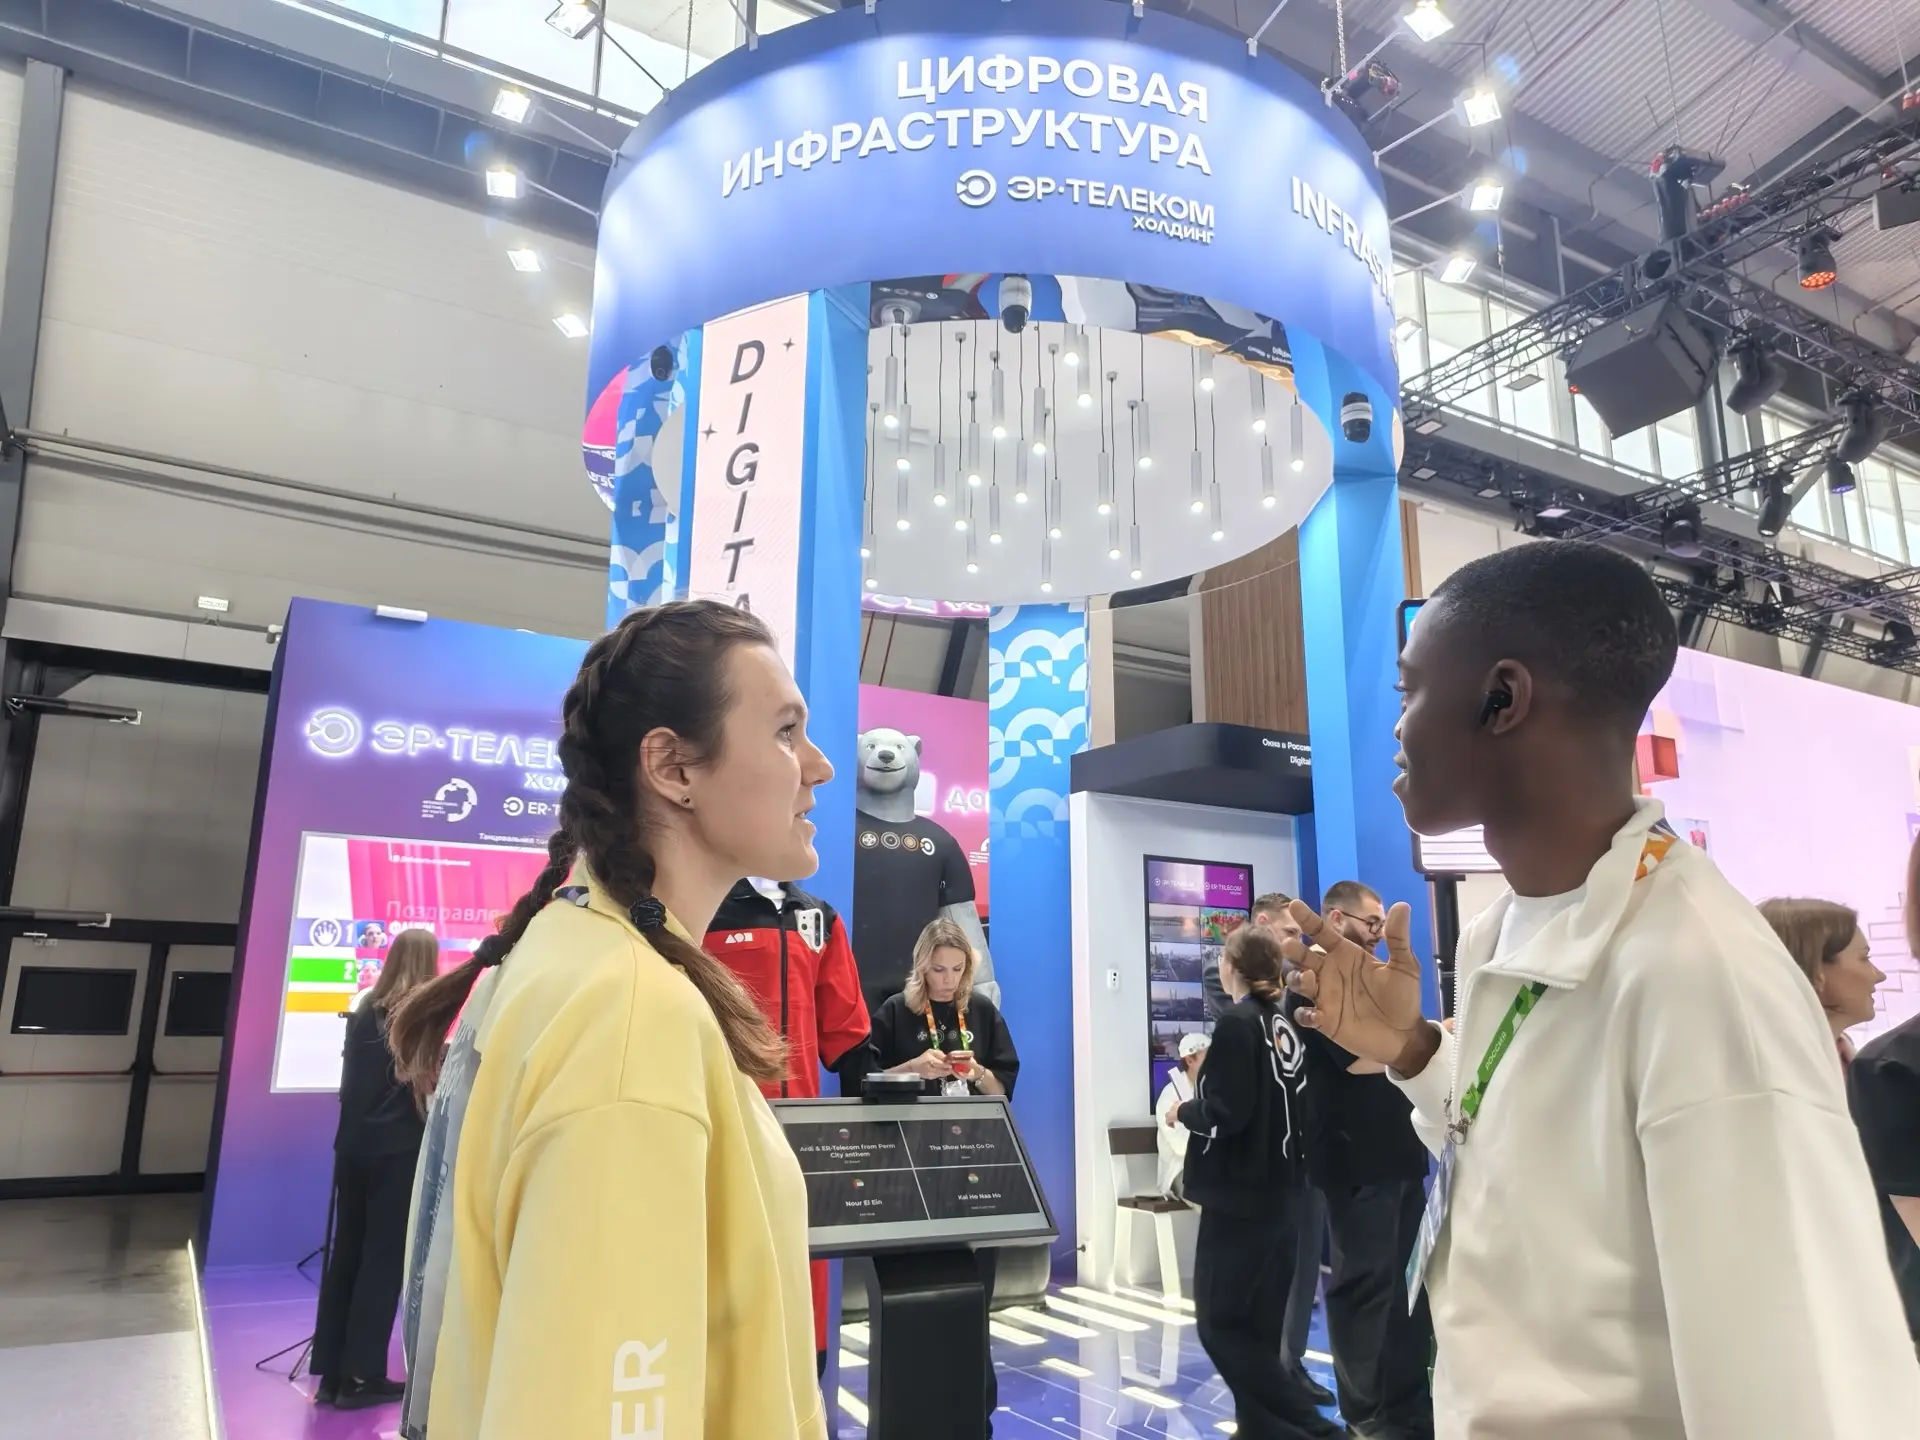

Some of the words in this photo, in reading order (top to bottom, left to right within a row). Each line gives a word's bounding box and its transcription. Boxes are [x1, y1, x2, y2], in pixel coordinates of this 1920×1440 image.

[897, 54, 1208, 122] ЦИФРОВАЯ
[721, 109, 1213, 197] ИНФРАСТРУКТУРА
[1133, 215, 1215, 246] ХОЛДИНГ
[1262, 738, 1280, 748] Окна
[346, 923, 354, 944] 1
[343, 961, 354, 981] 2
[1484, 1031, 1507, 1071] РОССИЯ
[609, 1336, 668, 1440] ER
